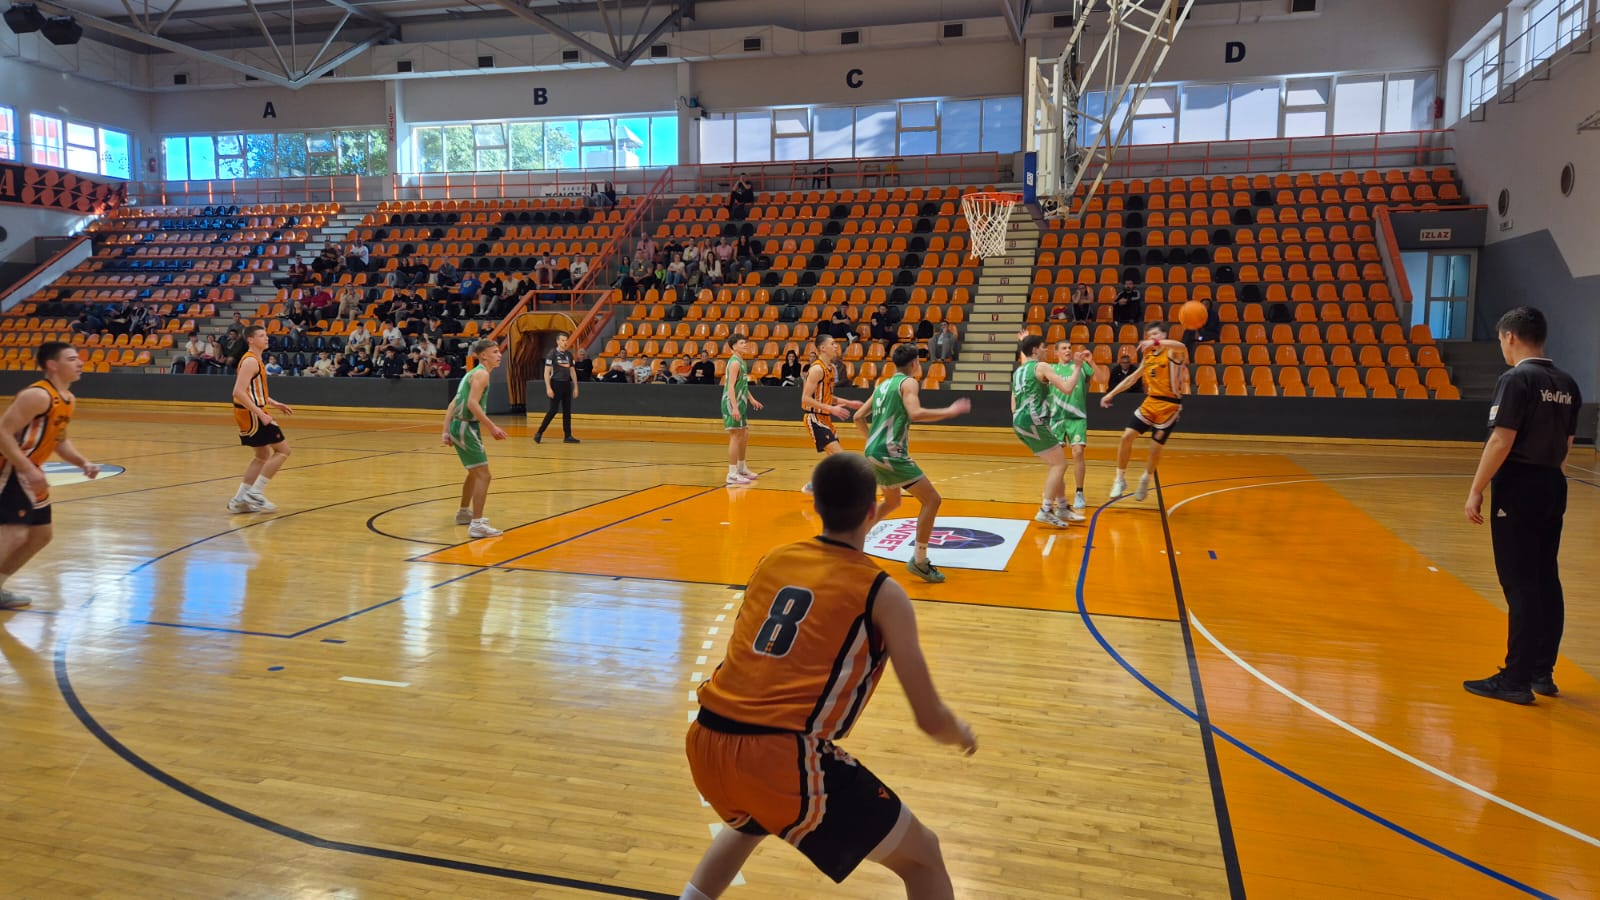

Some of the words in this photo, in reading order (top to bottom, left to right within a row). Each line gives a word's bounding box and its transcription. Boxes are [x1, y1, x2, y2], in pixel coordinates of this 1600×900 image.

[1225, 42, 1246, 63] D
[847, 69, 864, 89] C
[533, 87, 549, 106] B
[262, 101, 277, 119] A
[1421, 231, 1450, 240] IZLAZ
[752, 585, 815, 658] 8
